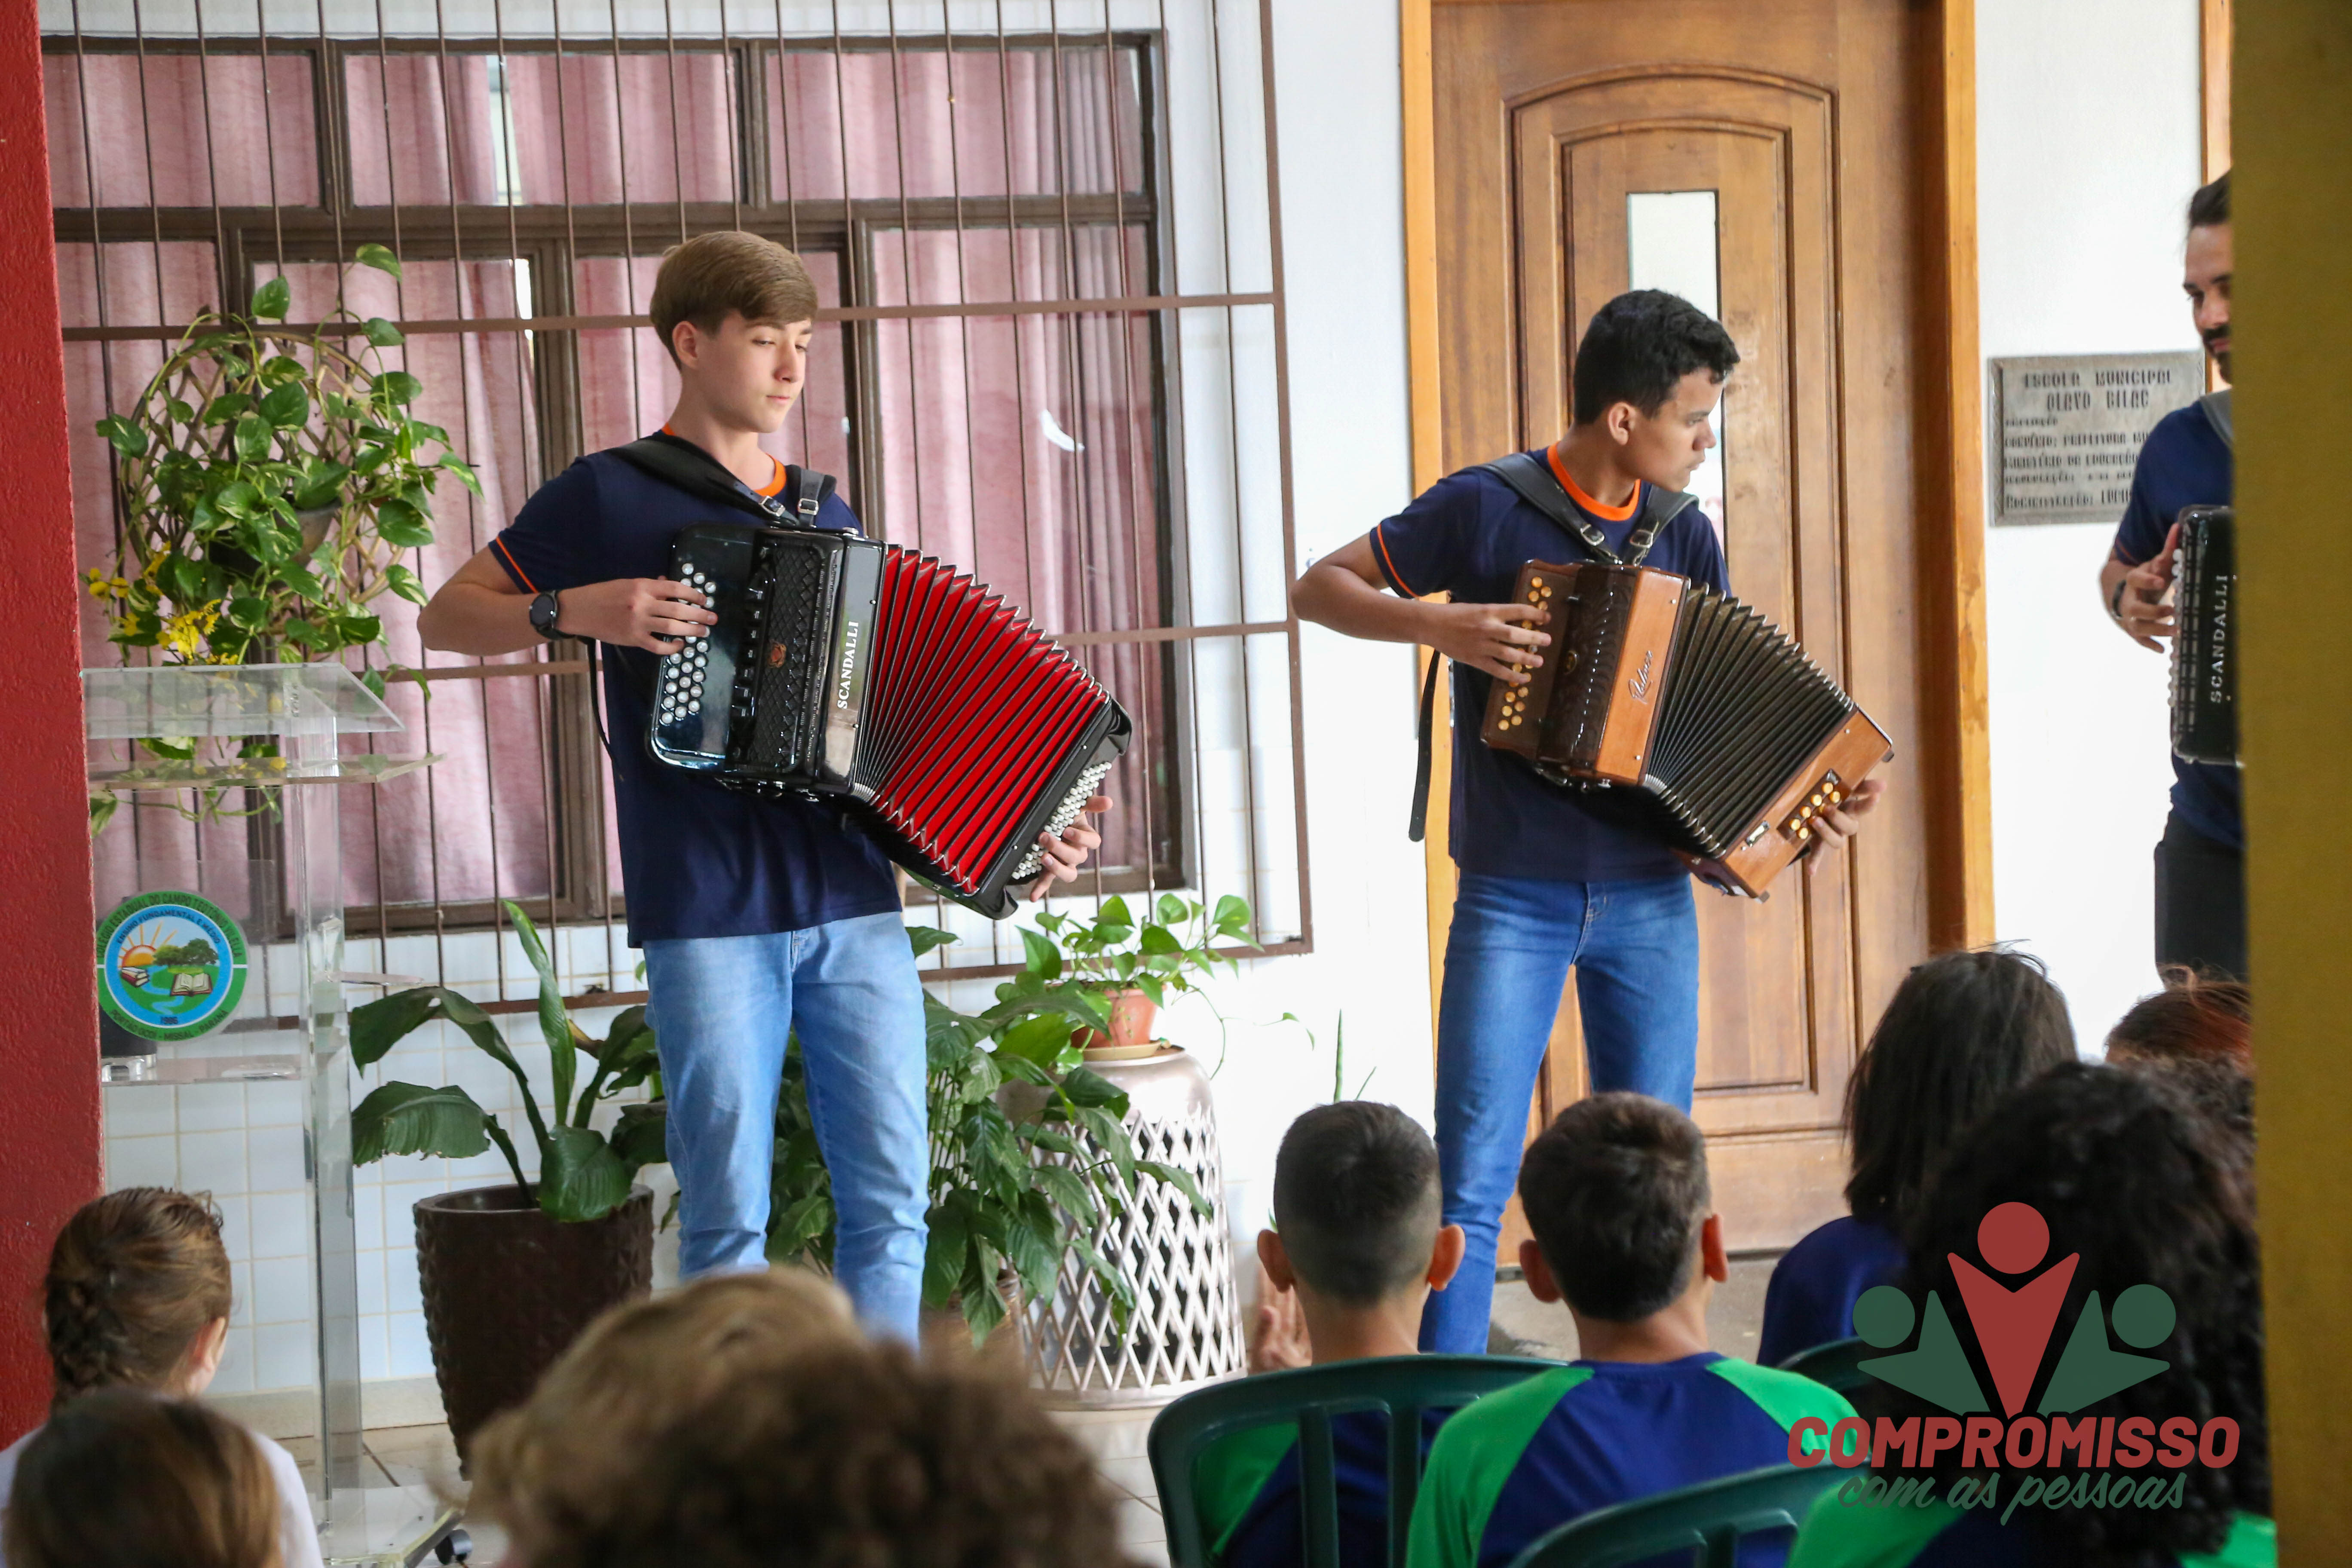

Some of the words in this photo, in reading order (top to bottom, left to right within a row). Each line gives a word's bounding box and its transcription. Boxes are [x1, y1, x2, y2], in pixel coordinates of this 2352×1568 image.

[837, 621, 859, 709] SCANDALLI
[2210, 575, 2228, 704] SCANDALLI
[138, 910, 194, 924] FUNDAMENTAL
[162, 894, 191, 906] CAMPO
